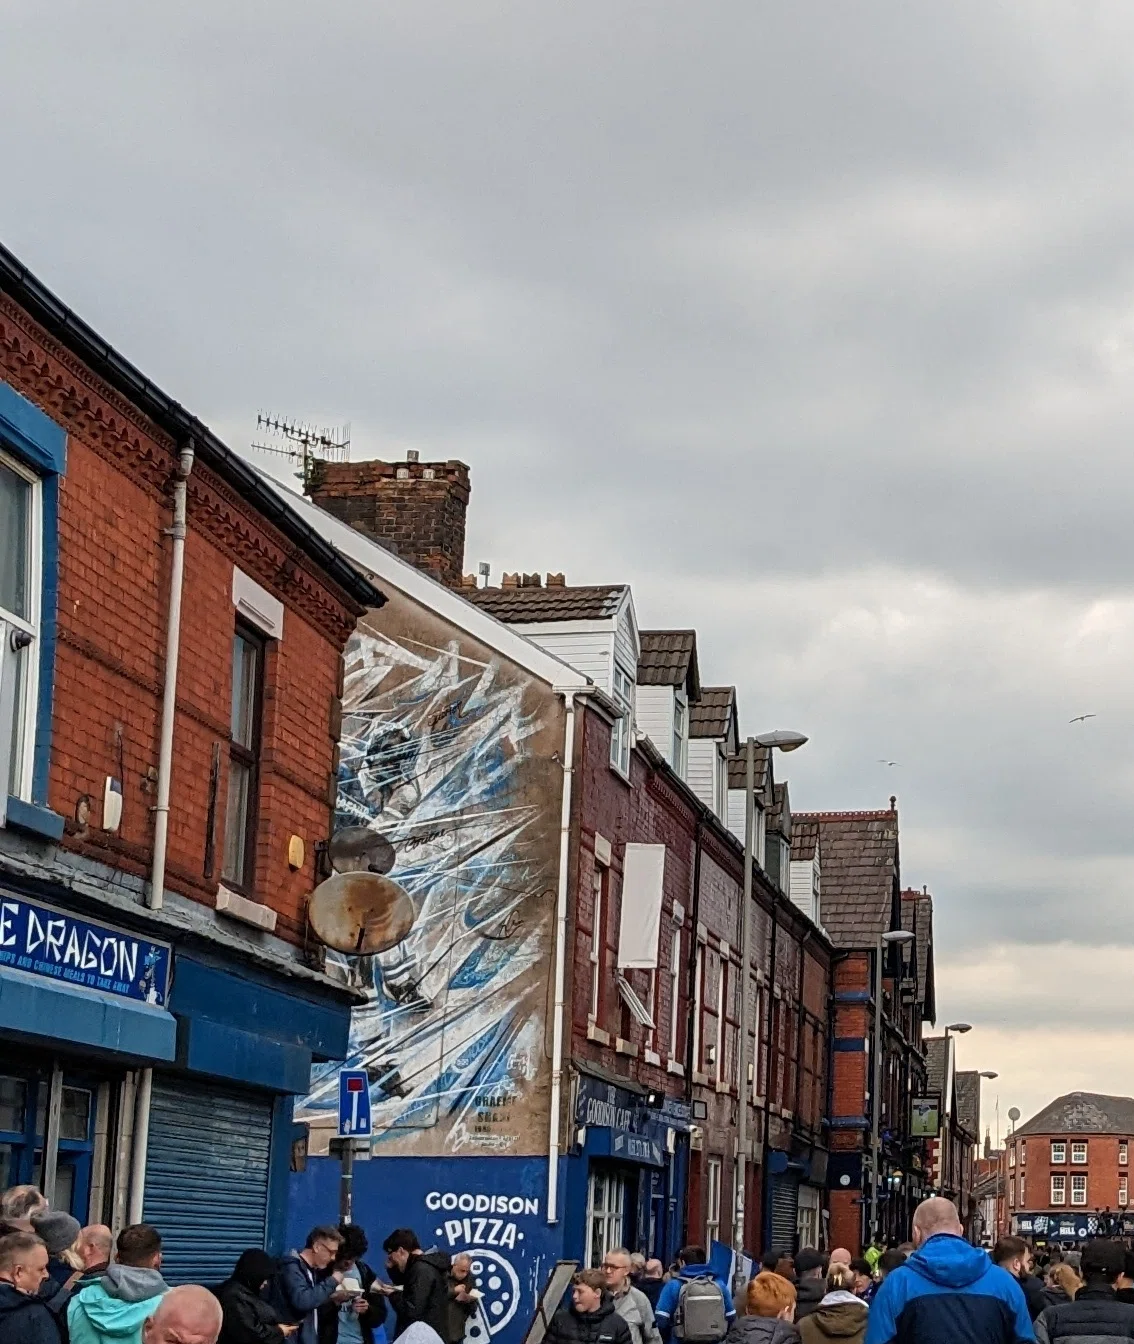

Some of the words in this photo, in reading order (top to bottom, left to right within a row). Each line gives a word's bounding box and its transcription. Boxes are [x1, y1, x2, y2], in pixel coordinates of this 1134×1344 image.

[25, 909, 139, 983] DRAGON
[17, 955, 33, 969] AND
[33, 959, 63, 976] CHINESE
[63, 967, 86, 983] MEALS
[425, 1191, 539, 1216] GOODISON
